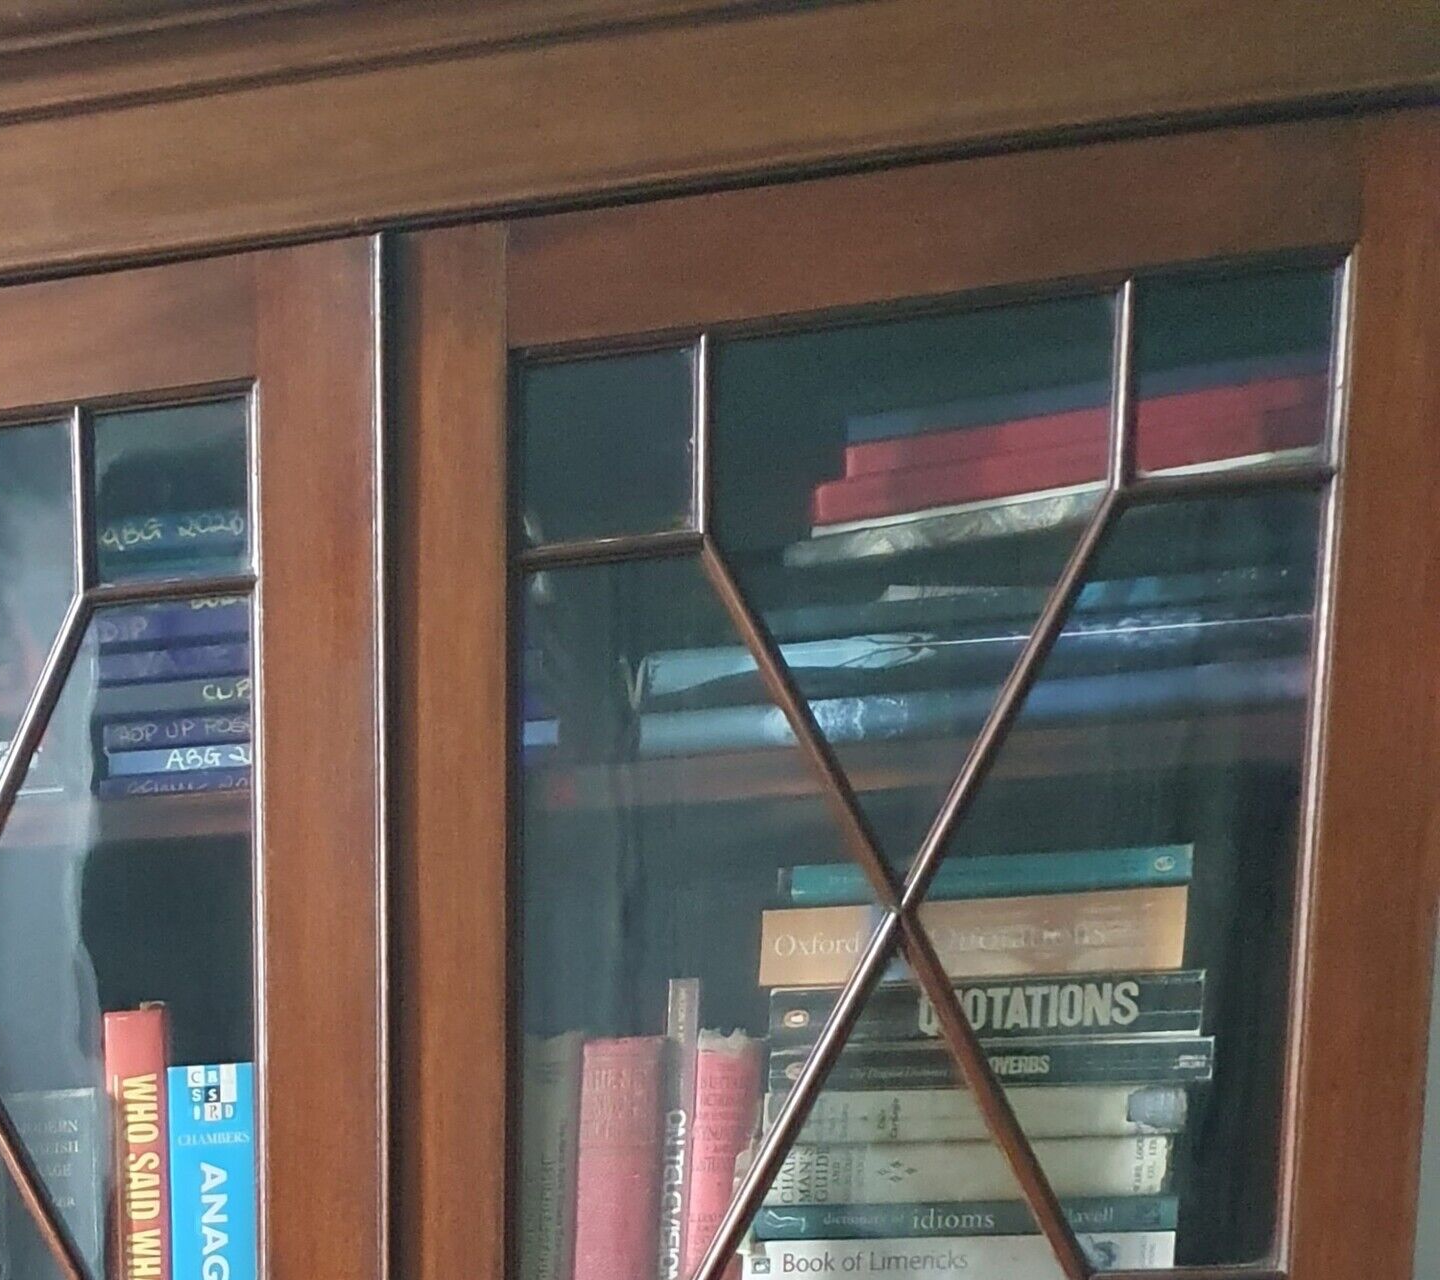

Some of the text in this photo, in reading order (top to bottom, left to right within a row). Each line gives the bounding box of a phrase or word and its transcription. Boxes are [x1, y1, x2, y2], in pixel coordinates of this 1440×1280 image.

[166, 747, 222, 770] ABG
[774, 931, 860, 957] Oxford
[918, 980, 1140, 1036] QOTATIONS
[989, 1055, 1051, 1074] OVERBS
[122, 1073, 160, 1144] WHO
[177, 1131, 250, 1147] CHAMBERS
[126, 1152, 161, 1221] SAID
[912, 1208, 996, 1230] idioms
[782, 1249, 969, 1274] Book of Limericks
